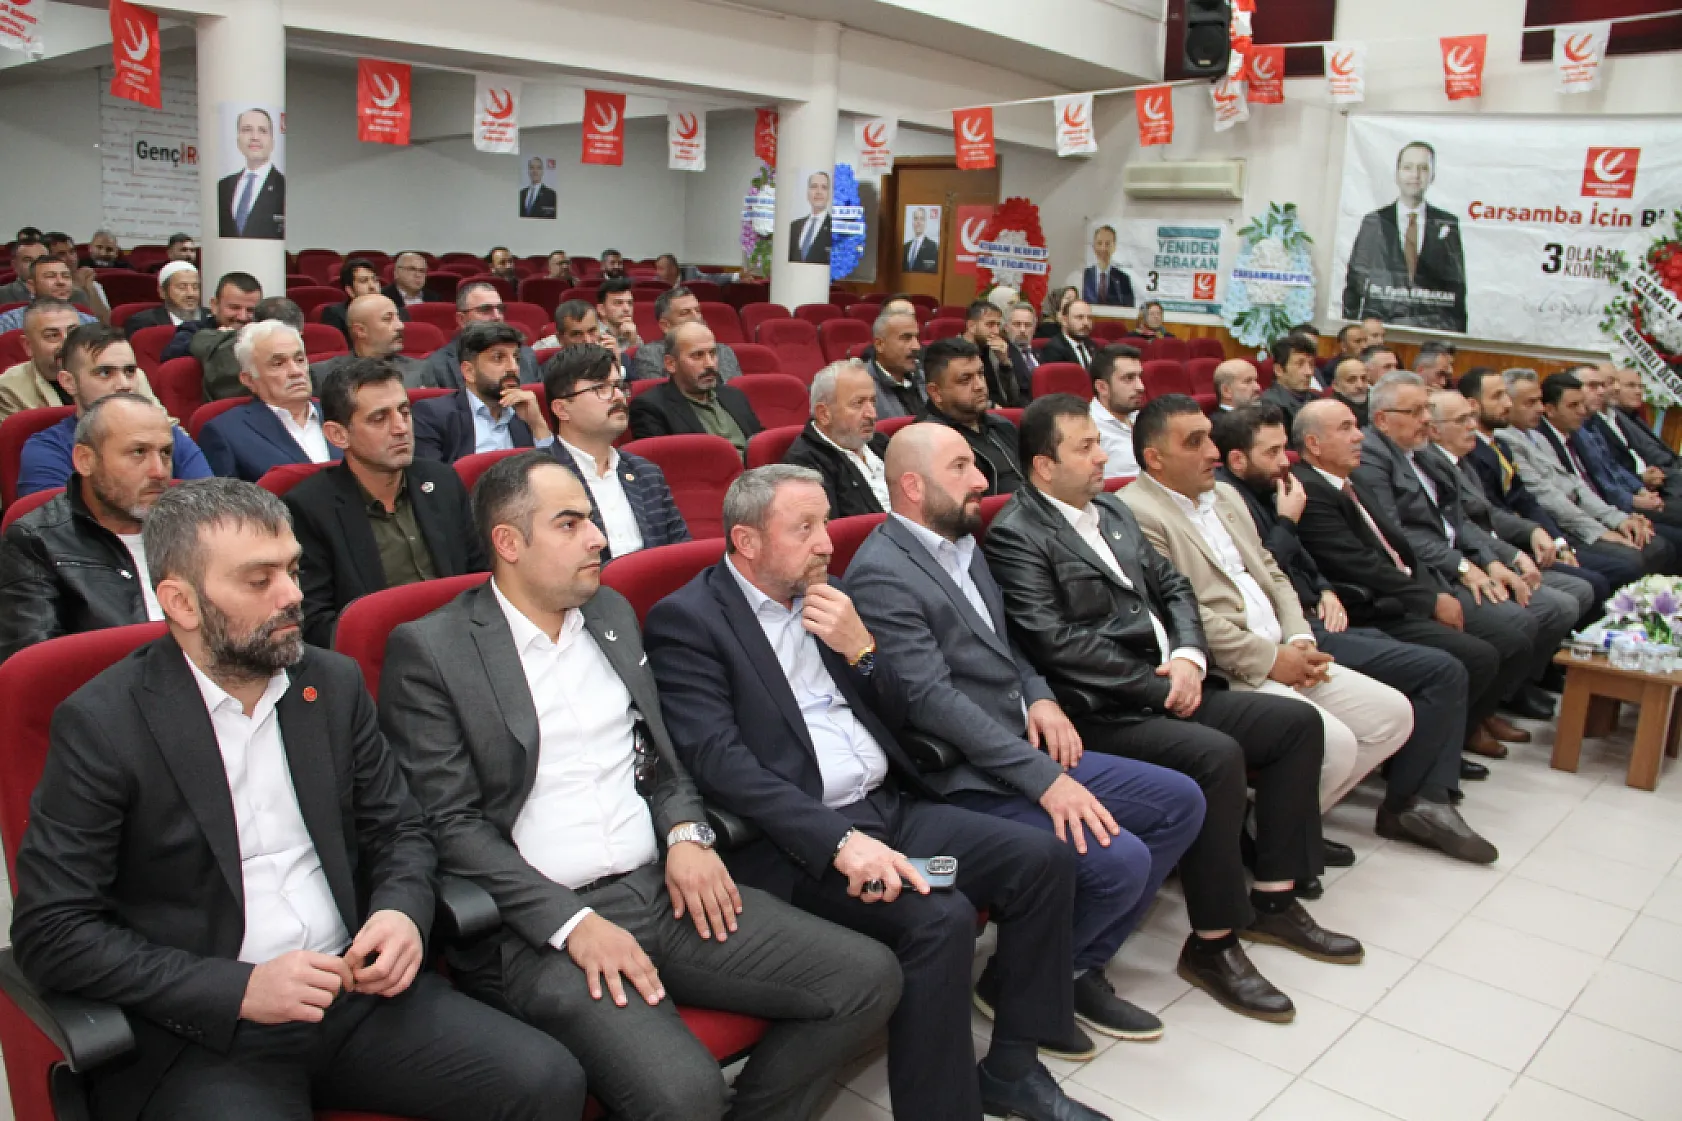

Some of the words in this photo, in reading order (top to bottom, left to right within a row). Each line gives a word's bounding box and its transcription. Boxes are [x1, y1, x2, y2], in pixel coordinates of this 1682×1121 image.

[1468, 201, 1582, 225] Çarşamba
[1590, 201, 1633, 227] İçin
[1154, 254, 1218, 270] ERBAKAN
[1542, 242, 1563, 273] 3
[1146, 271, 1159, 291] 3
